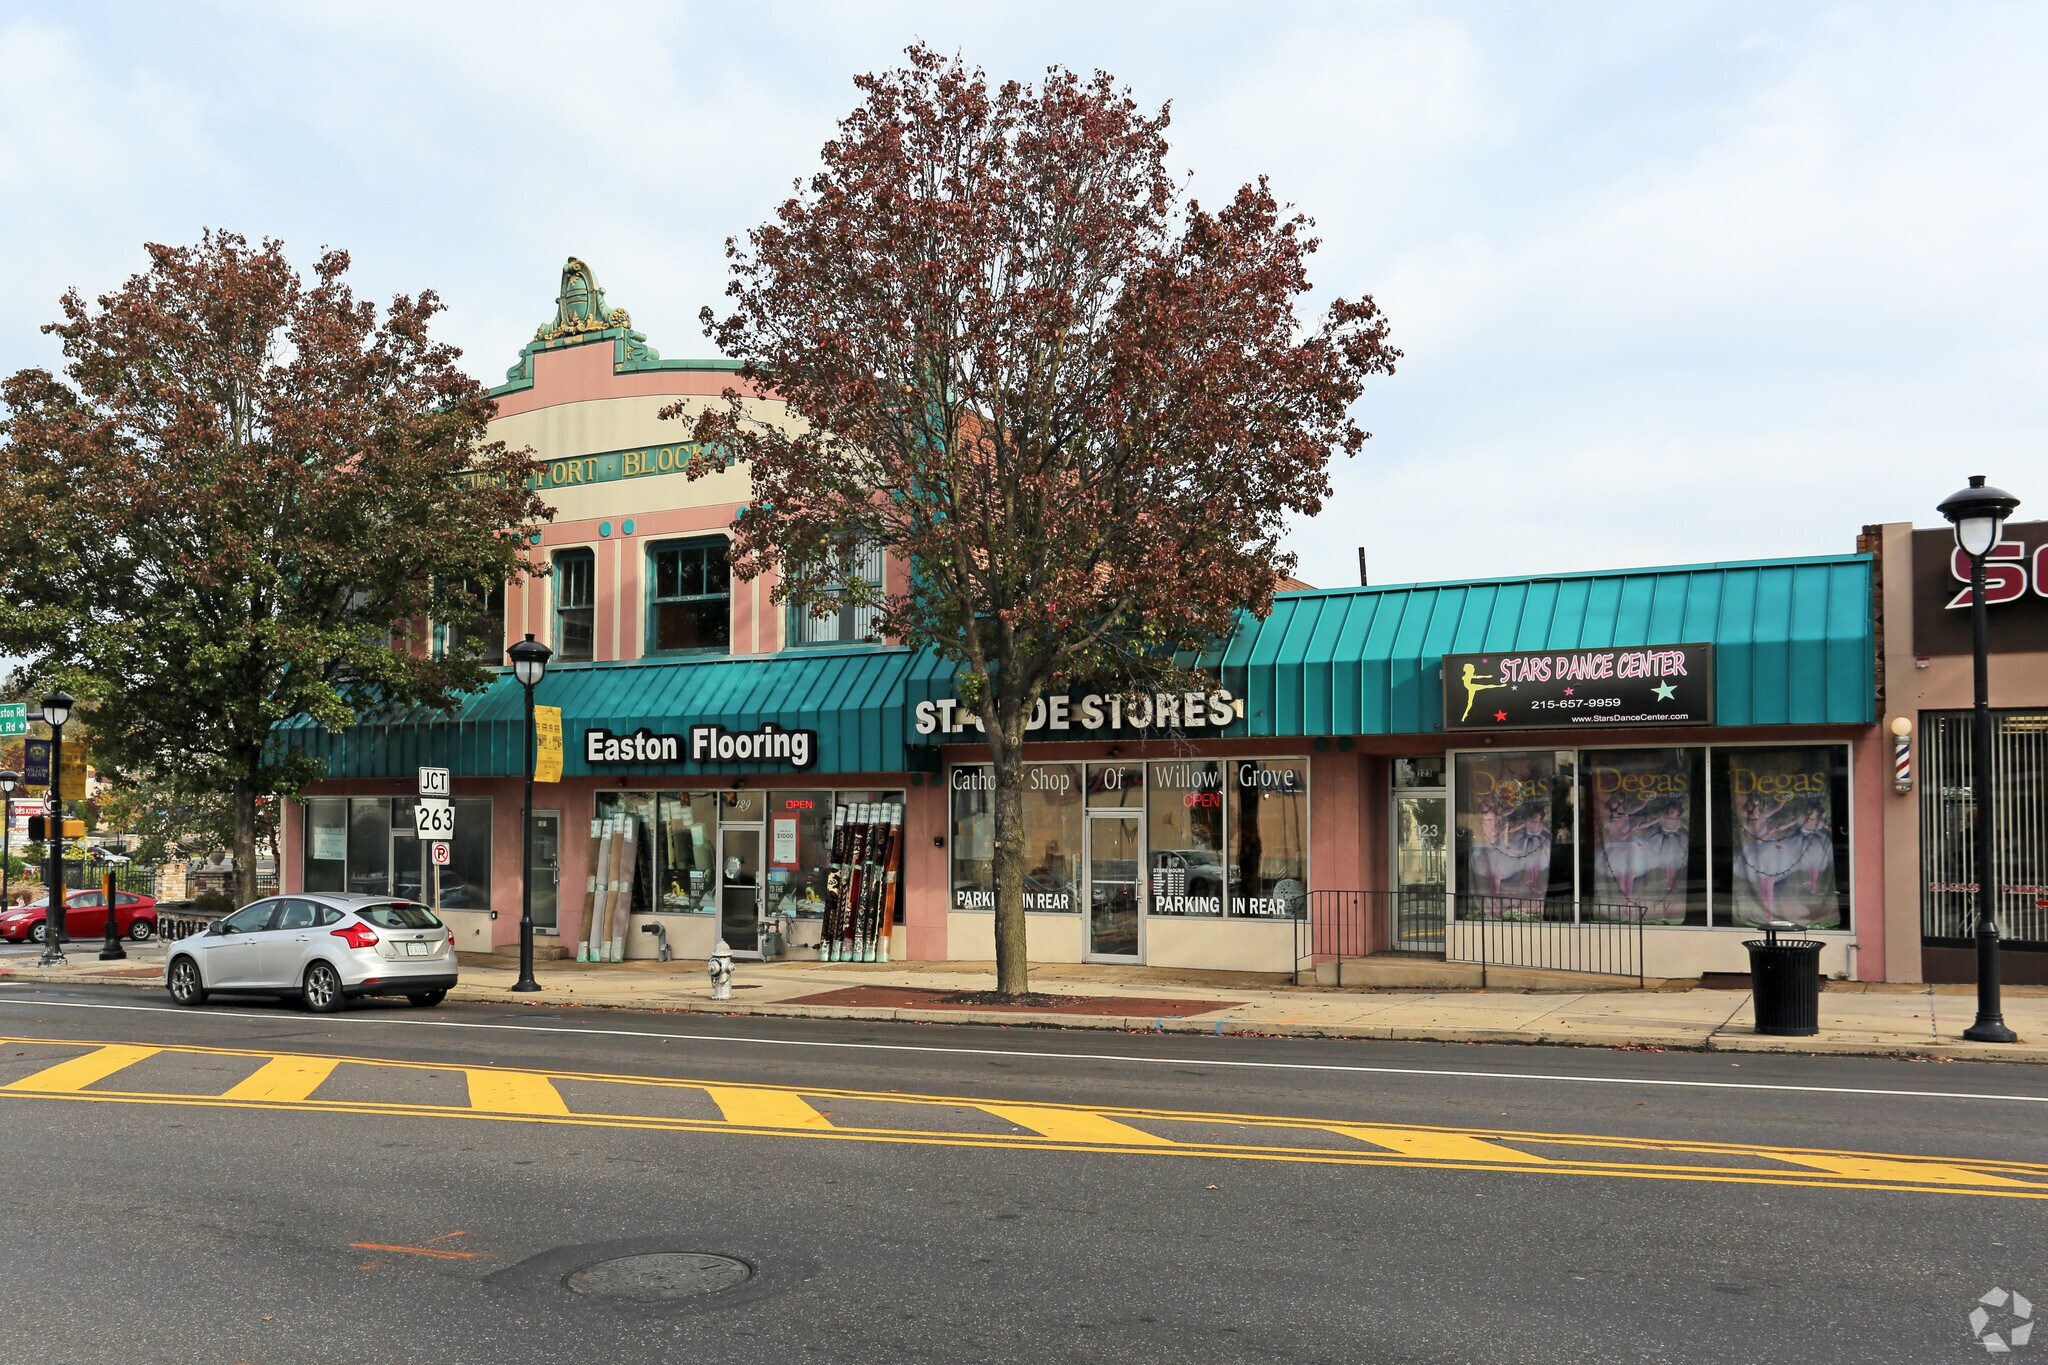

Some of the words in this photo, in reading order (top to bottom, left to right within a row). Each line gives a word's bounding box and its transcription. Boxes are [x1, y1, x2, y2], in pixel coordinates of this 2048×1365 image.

[1944, 541, 2048, 610] S
[1500, 656, 1551, 684] STARS
[1556, 652, 1614, 681] DANCE
[1617, 649, 1688, 680] CENTER
[0, 707, 15, 718] ston
[16, 707, 25, 718] Rd
[915, 698, 964, 735] ST.
[1081, 690, 1234, 730] STORES
[1531, 697, 1622, 711] 215-657-9959
[5, 722, 16, 732] Rd
[1571, 712, 1689, 724] www.StarsDanceCenter.com
[588, 731, 678, 762] Easton
[693, 726, 809, 767] Flooring
[423, 771, 447, 790] JCT
[952, 768, 996, 791] Catho
[1031, 767, 1070, 796] Shop
[1104, 766, 1127, 790] Of
[1156, 764, 1218, 788] Willow
[1240, 763, 1294, 787] Grove
[1595, 767, 1688, 801] Degas
[1733, 767, 1826, 802] Degas
[735, 799, 751, 812] 129
[785, 799, 813, 810] OPEN
[1183, 793, 1221, 808] OPEN
[419, 807, 453, 831] 263
[1417, 824, 1438, 837] 123
[957, 890, 995, 907] PARKI
[1022, 893, 1034, 908] IN
[1037, 893, 1069, 909] REAR
[1156, 895, 1220, 913] PARKING
[1232, 897, 1246, 914] IN
[1249, 898, 1286, 915] REAR
